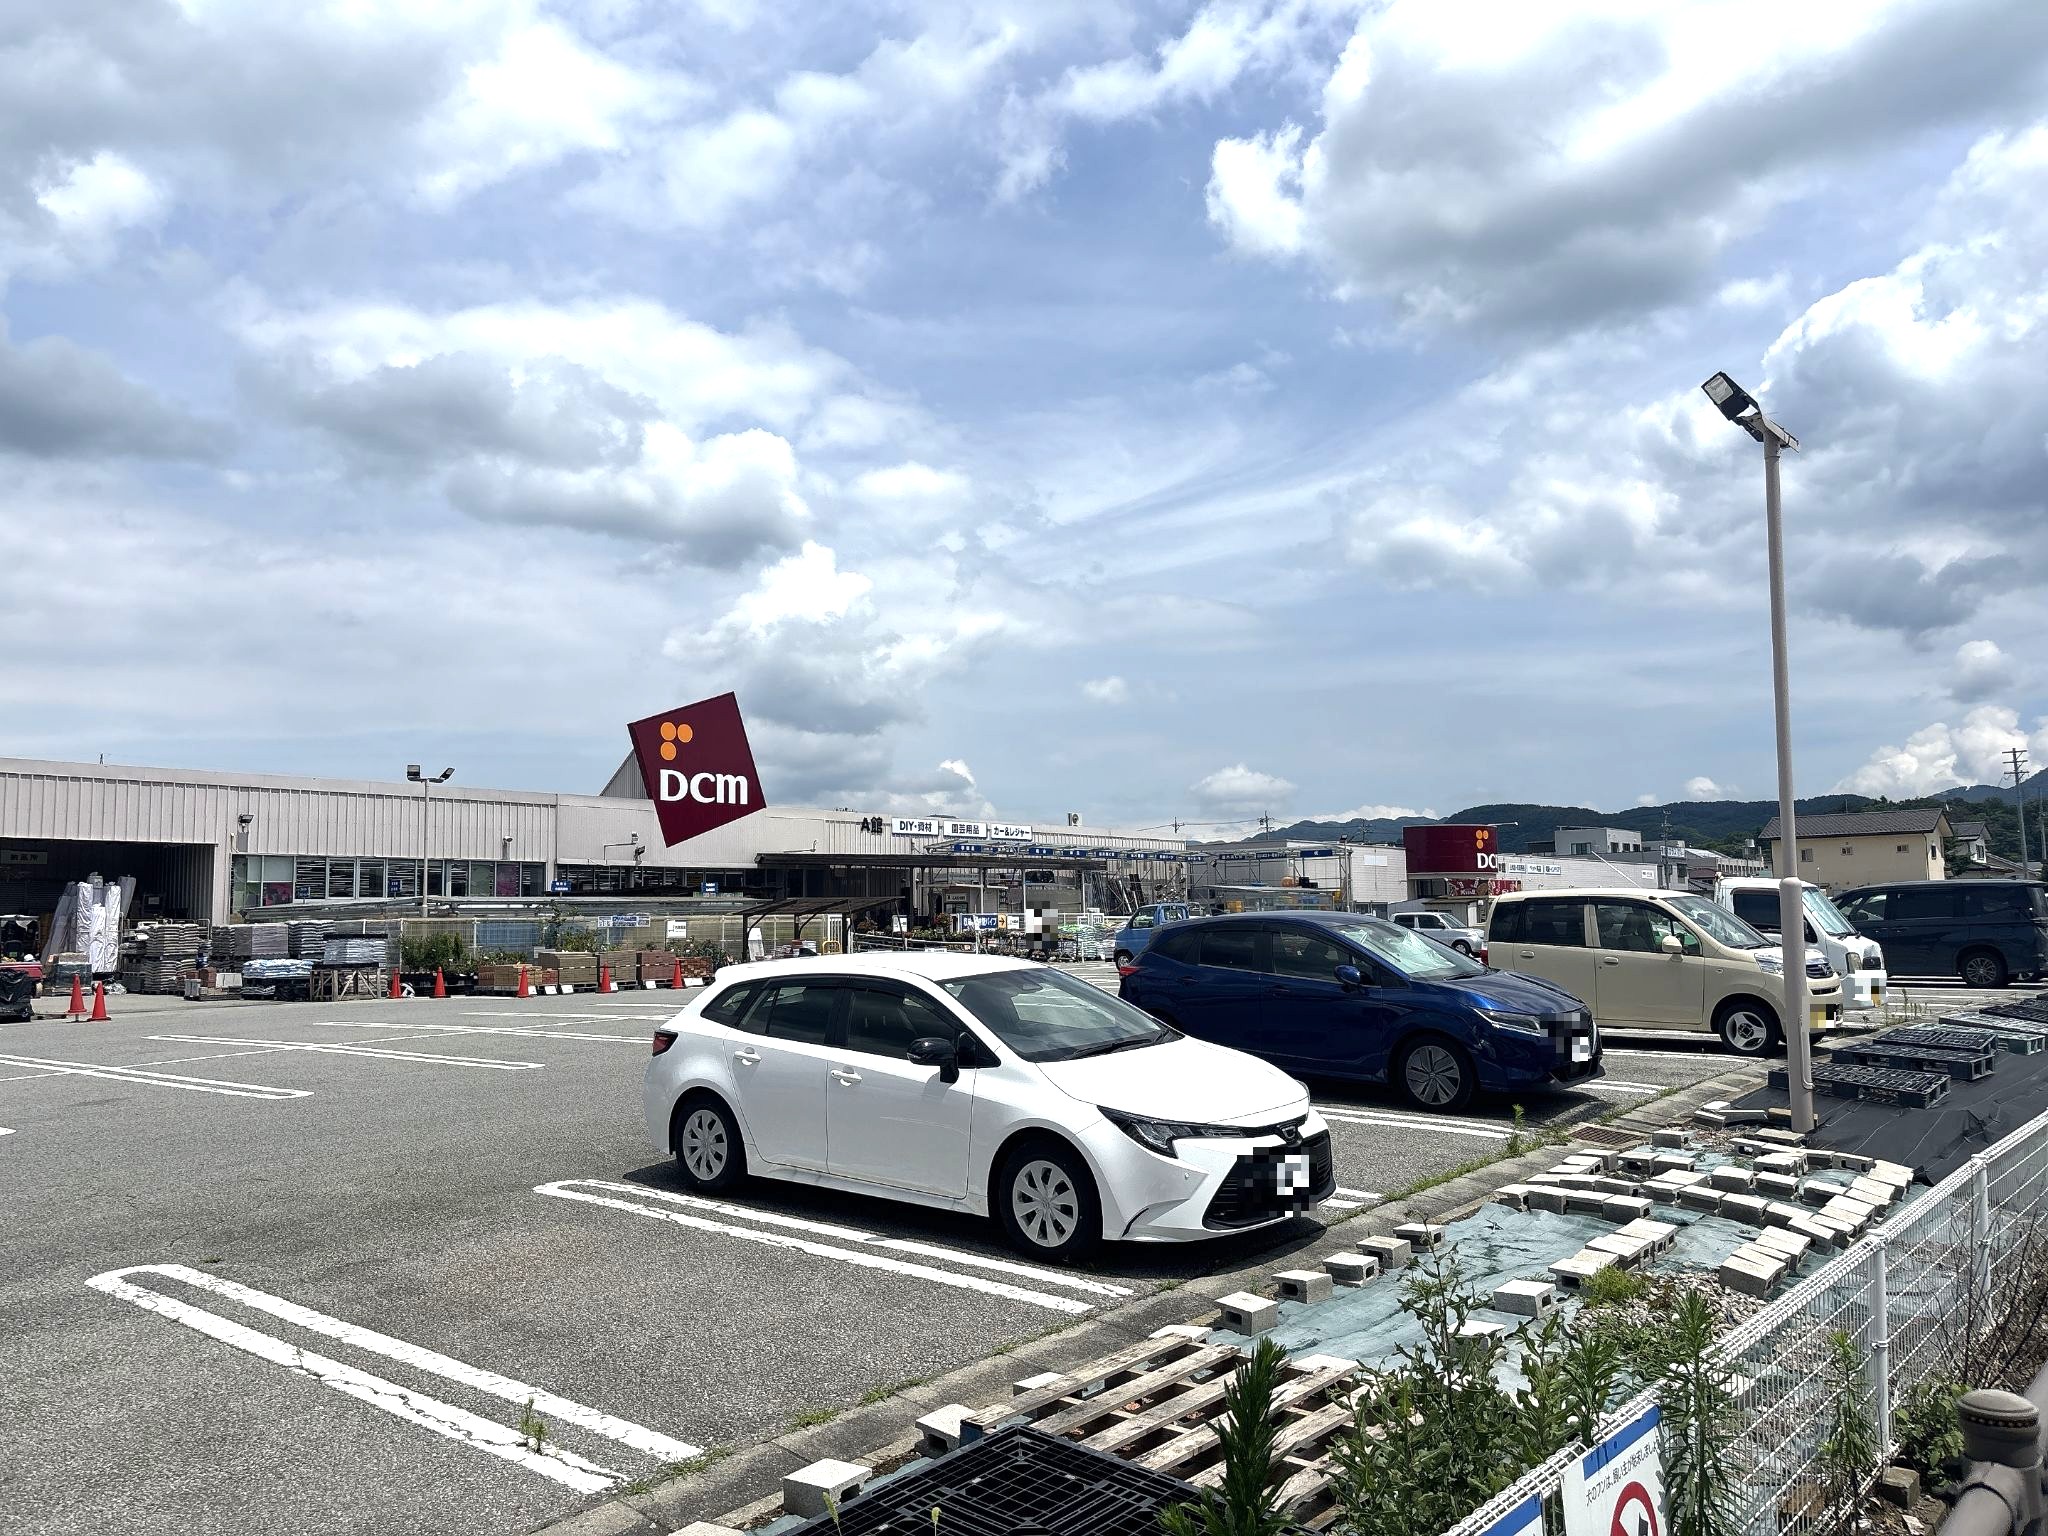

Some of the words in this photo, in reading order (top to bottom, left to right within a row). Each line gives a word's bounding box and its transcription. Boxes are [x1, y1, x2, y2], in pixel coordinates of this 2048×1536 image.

[860, 816, 883, 834] A館
[899, 820, 932, 833] DIY・資材
[951, 823, 980, 835] 園芸用品
